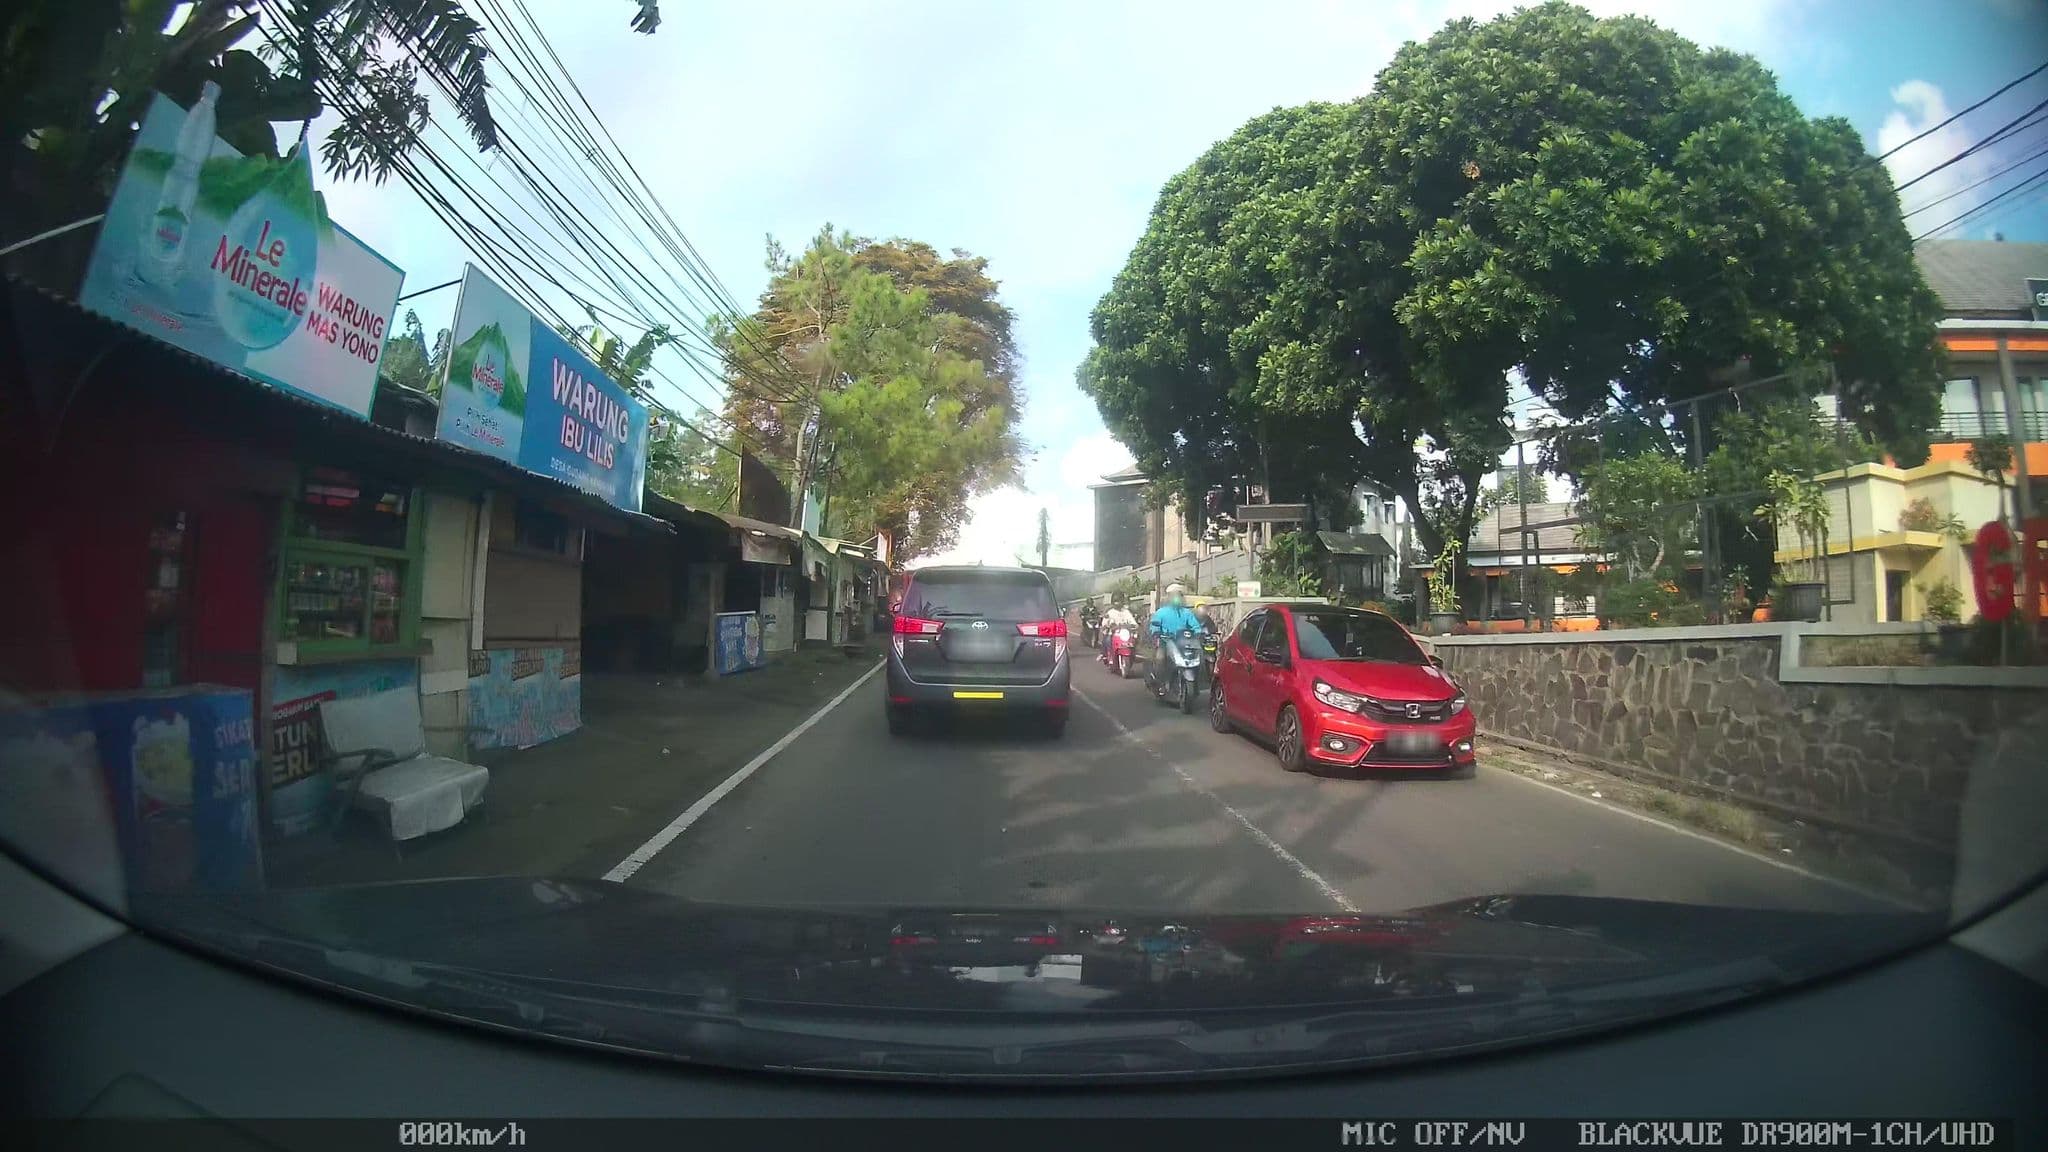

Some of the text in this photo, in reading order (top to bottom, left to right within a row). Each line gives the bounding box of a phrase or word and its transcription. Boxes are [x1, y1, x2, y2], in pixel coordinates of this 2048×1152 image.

[255, 220, 285, 267] Le
[210, 234, 309, 316] Minerale
[306, 310, 379, 364] MAS YONO
[318, 281, 385, 339] WARUNG
[471, 362, 505, 394] Minerale
[552, 356, 630, 444] WARUNG
[560, 414, 615, 469] IBU LILIS
